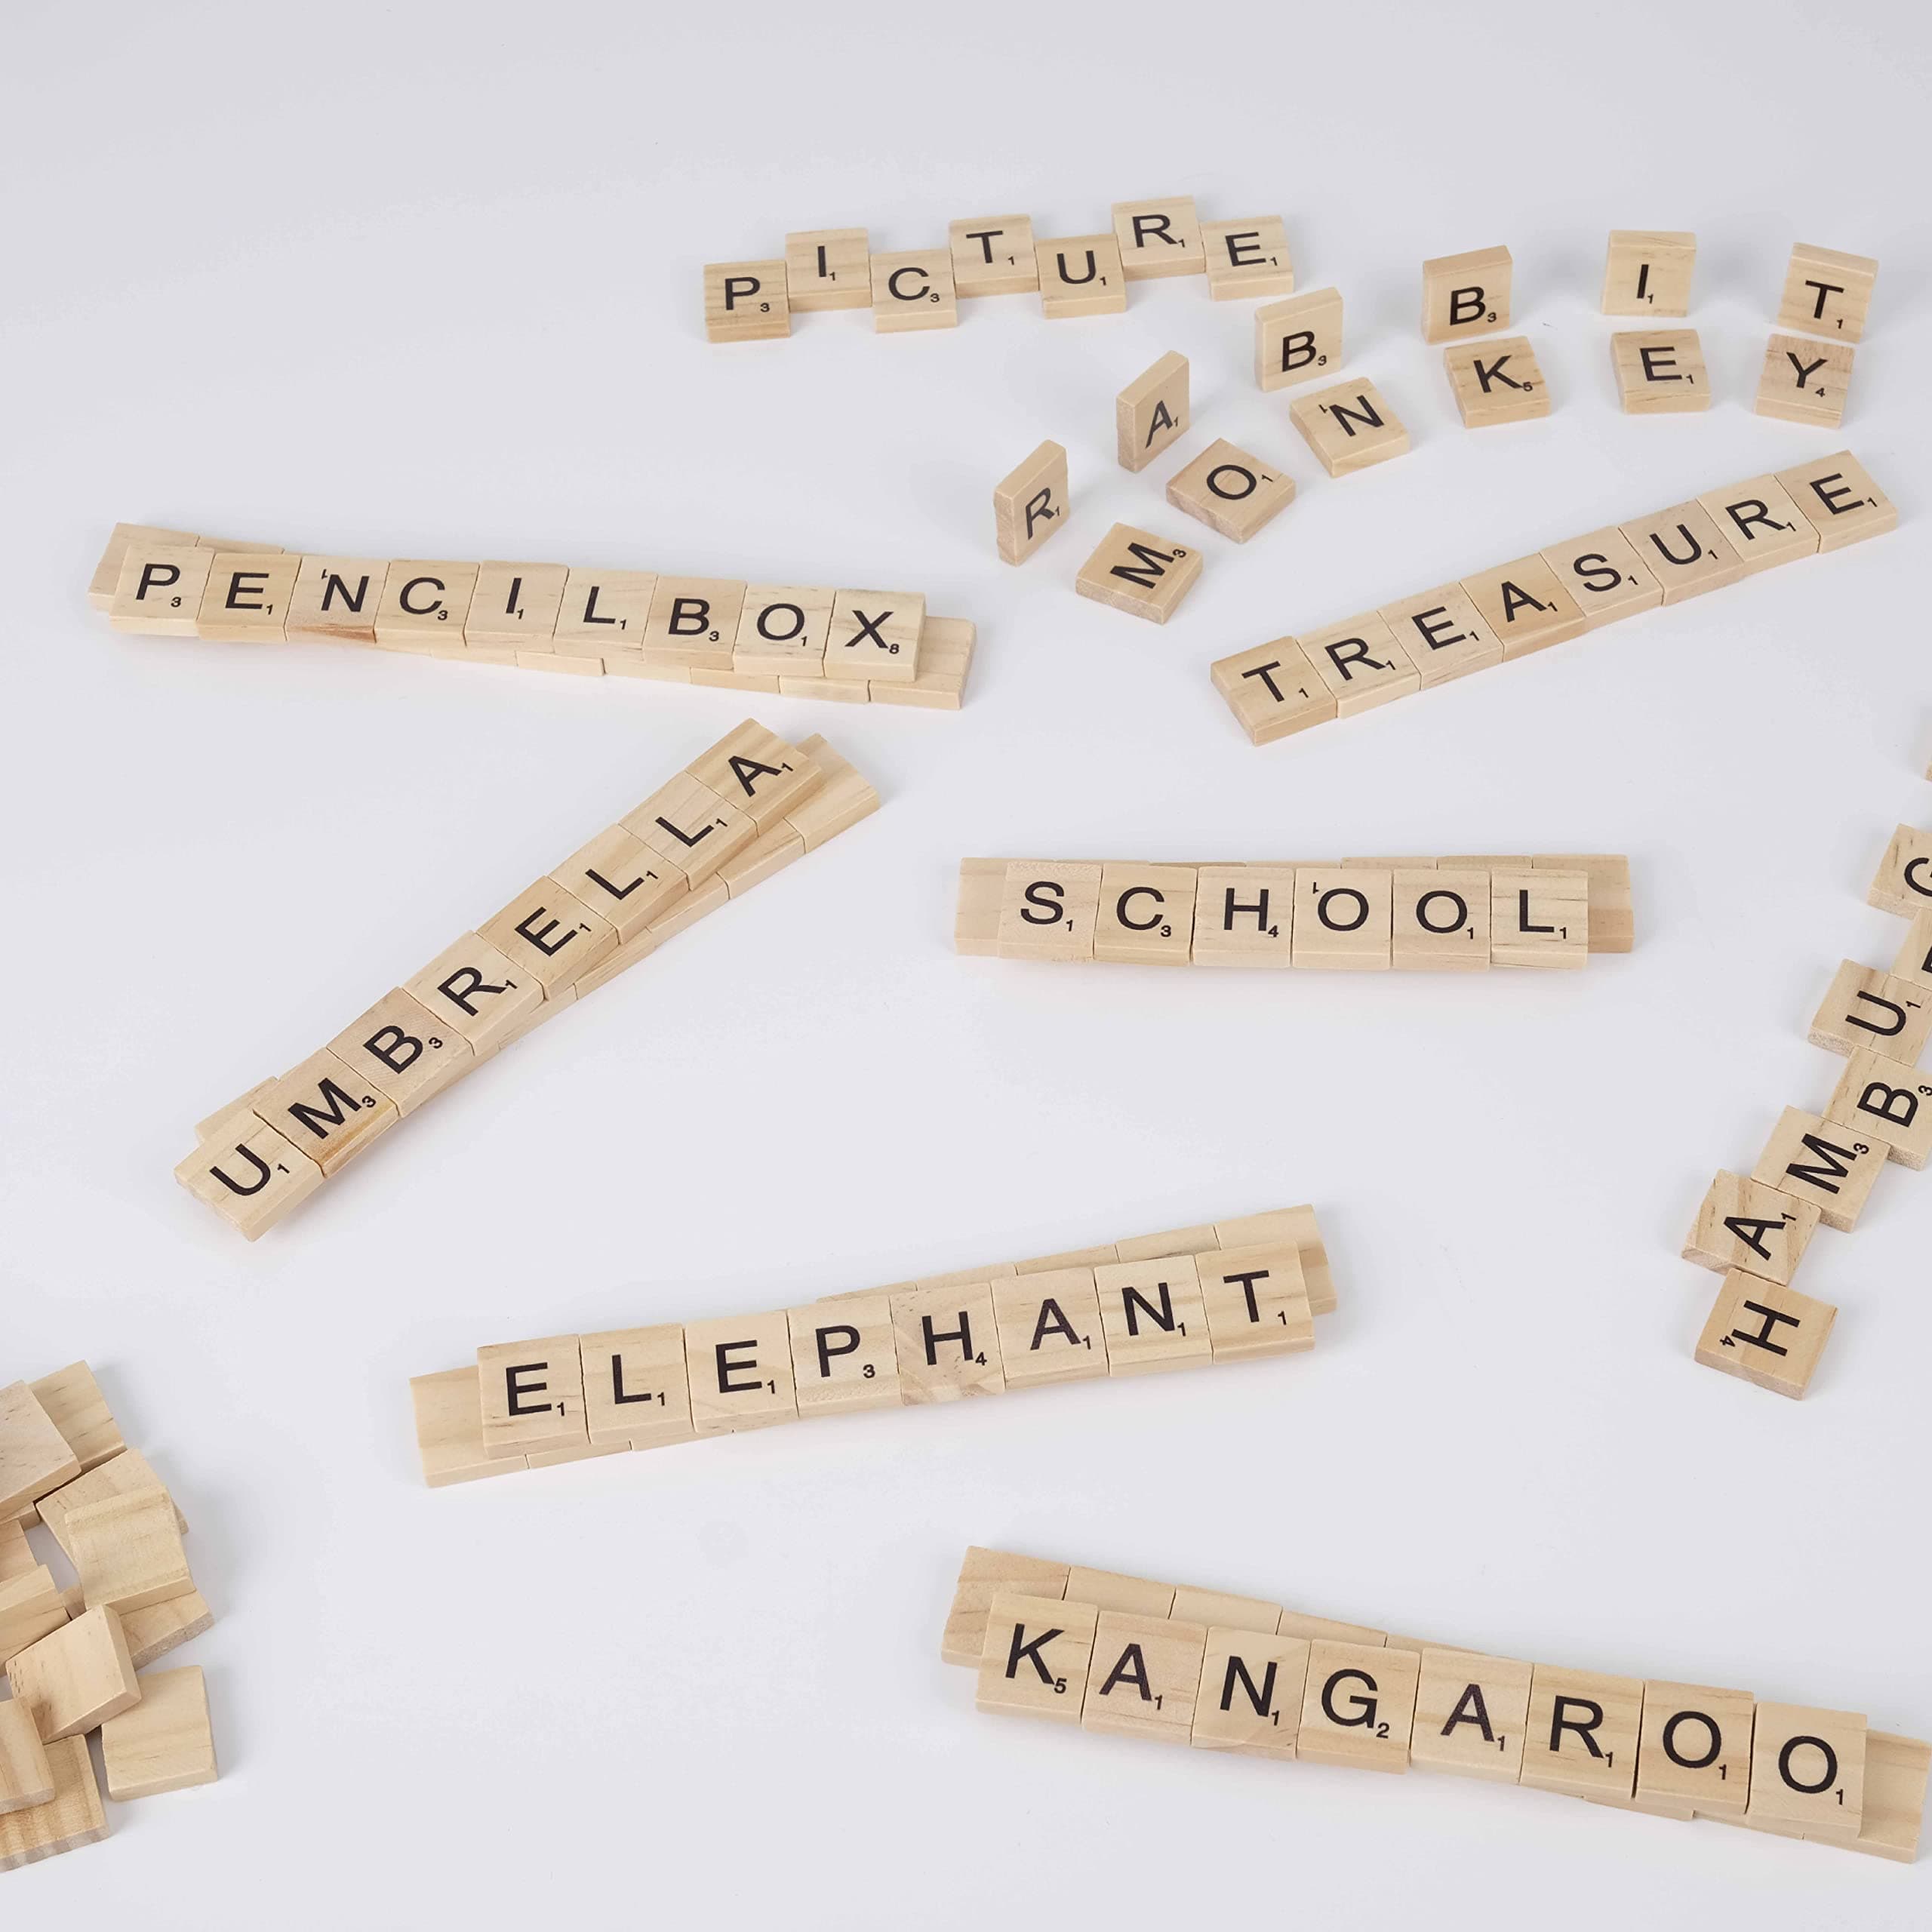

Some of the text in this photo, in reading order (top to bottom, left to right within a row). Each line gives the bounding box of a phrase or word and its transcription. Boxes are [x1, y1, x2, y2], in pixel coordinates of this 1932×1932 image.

[724, 214, 1267, 312] PICTURE
[1023, 263, 1845, 542] RABBIT
[1109, 346, 1829, 590] MONKEY
[134, 562, 894, 650] PENCILBOX
[1241, 472, 1866, 703] TREASURE
[208, 755, 783, 1197] UMBRELLA
[1020, 880, 1555, 934] SCHOOL
[1722, 856, 1932, 1358] HAMBUG
[505, 1269, 1270, 1417] ELEPHANT
[1004, 1622, 1838, 1795] KANGAROO
